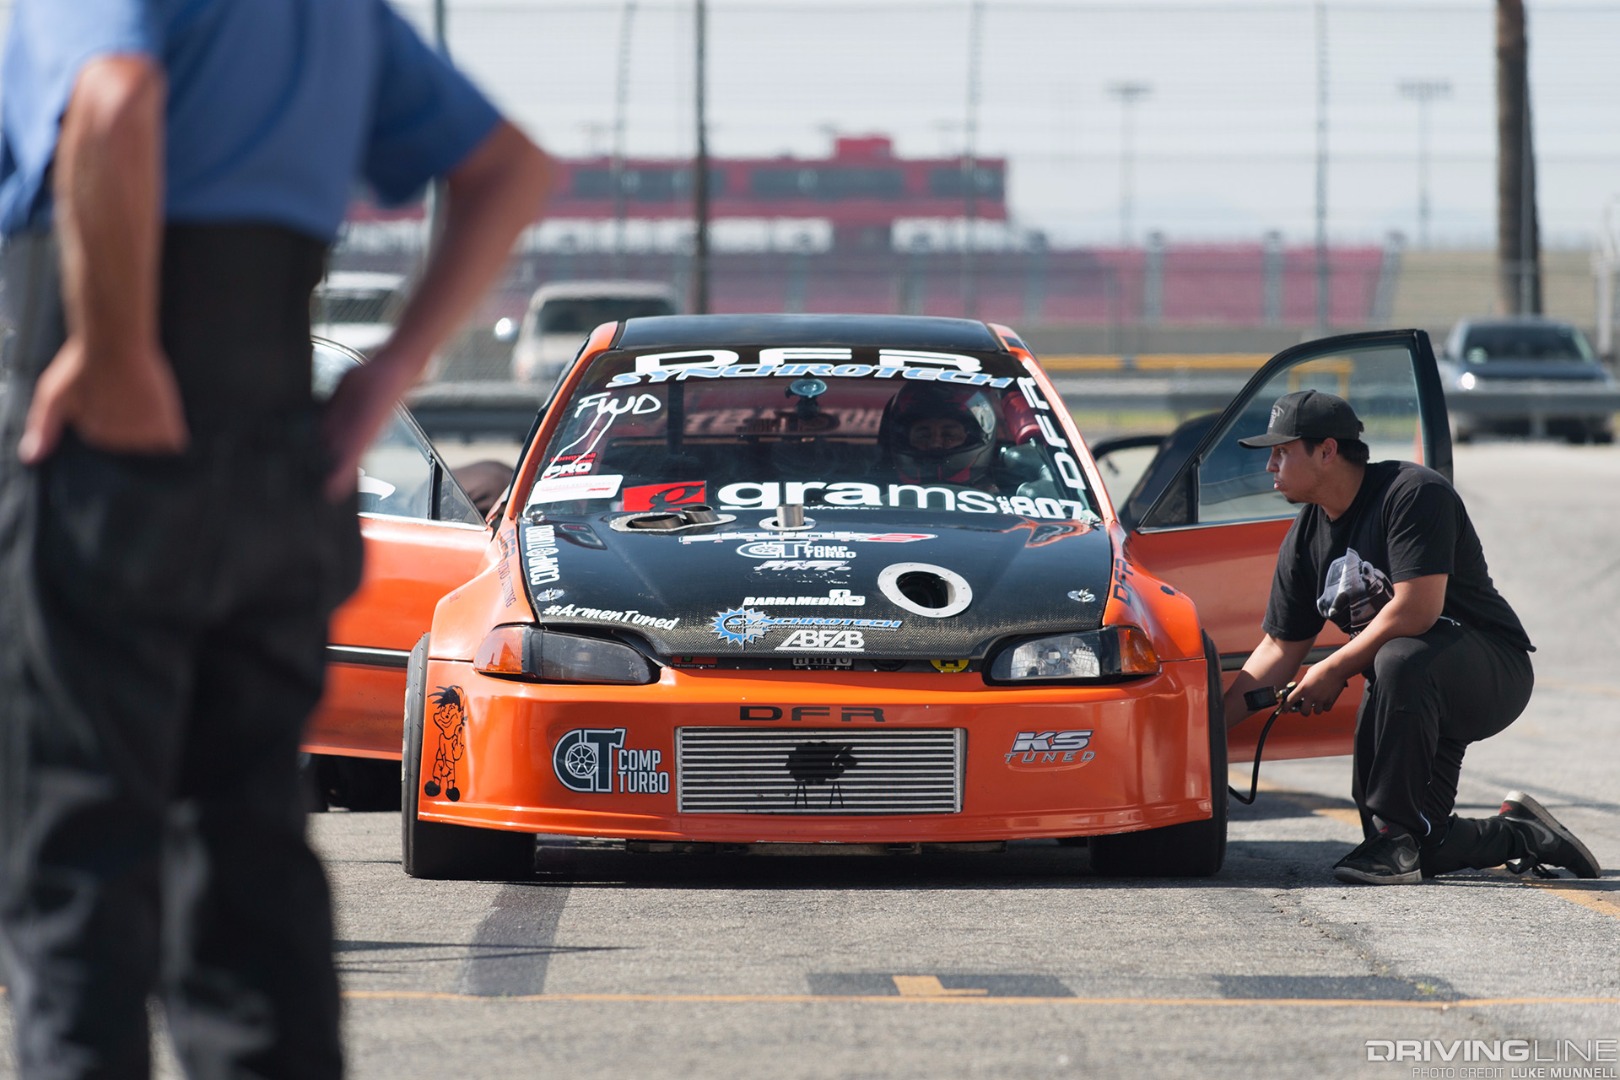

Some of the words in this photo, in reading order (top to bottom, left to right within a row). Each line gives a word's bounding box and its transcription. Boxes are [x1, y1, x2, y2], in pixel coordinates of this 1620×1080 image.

[606, 364, 1014, 388] SYNCHROTECH
[574, 392, 661, 418] FWD
[1017, 377, 1087, 490] DFR
[545, 463, 593, 478] PRO
[717, 481, 998, 514] grams
[1010, 496, 1083, 519] 807
[806, 551, 857, 559] TURBO
[528, 555, 560, 586] COMP
[542, 603, 680, 631] #ArmenTuned
[726, 616, 903, 629] SYNCHROTECH
[776, 630, 865, 651] ABFAB
[739, 705, 886, 722] DFR
[1011, 730, 1093, 752] KS
[617, 749, 661, 772] COMP
[1004, 751, 1096, 764] TUNED
[617, 771, 670, 794] TURBO
